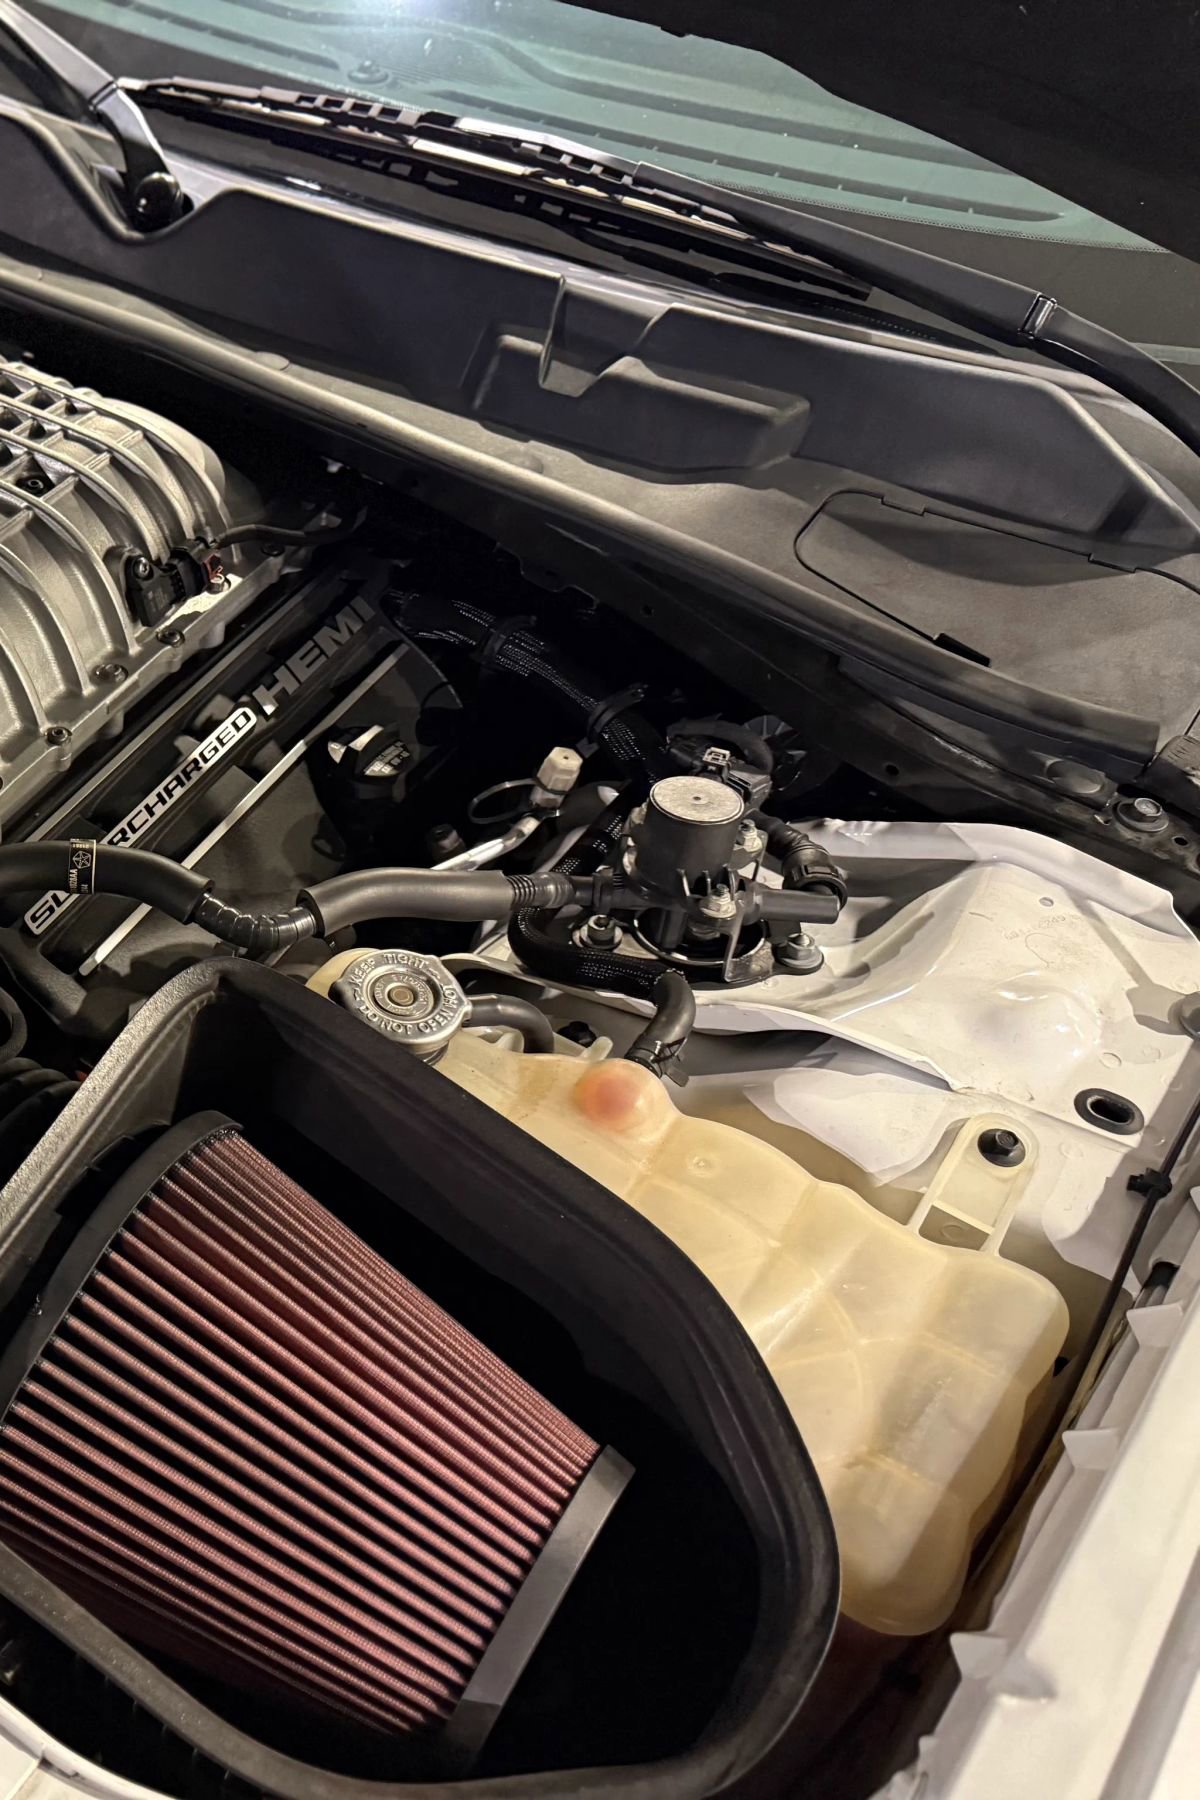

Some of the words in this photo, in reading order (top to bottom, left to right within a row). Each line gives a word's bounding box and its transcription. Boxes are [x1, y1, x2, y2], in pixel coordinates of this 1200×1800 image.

[30, 708, 254, 929] SURCHARGED
[254, 597, 375, 716] HEMI
[349, 958, 376, 986] KEEP
[383, 953, 429, 969] TIGHT
[380, 1019, 413, 1034] NOT
[417, 1008, 454, 1033] OPEN
[442, 984, 459, 1009] HOT
